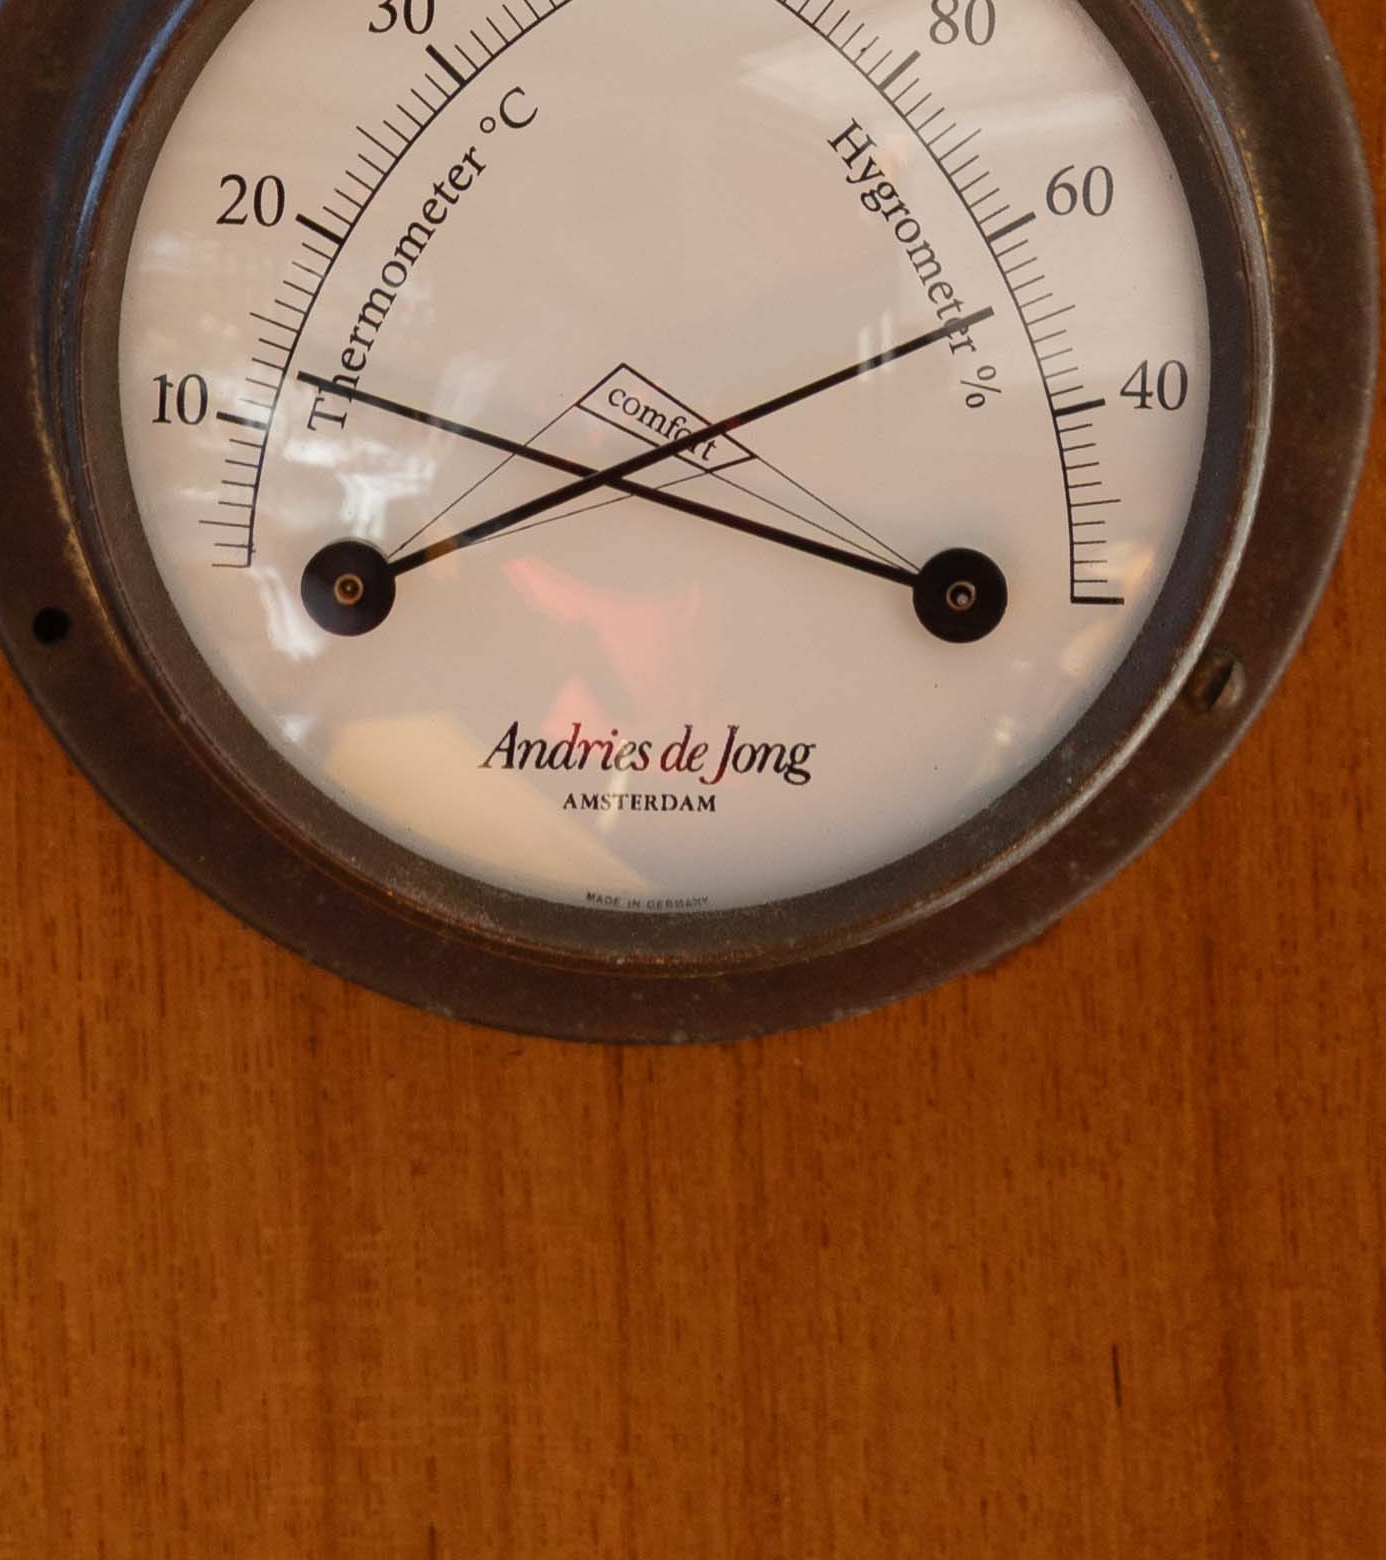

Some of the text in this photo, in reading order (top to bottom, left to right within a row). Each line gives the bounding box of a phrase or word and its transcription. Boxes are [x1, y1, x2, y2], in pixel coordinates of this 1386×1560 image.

[216, 175, 286, 227] 20
[1045, 167, 1114, 216] 60
[307, 147, 487, 433] Thermometer
[150, 373, 209, 425] 10
[1120, 360, 1188, 411] 40
[477, 720, 816, 786] Andries de Jong
[563, 792, 717, 813] AMSTERDAM
